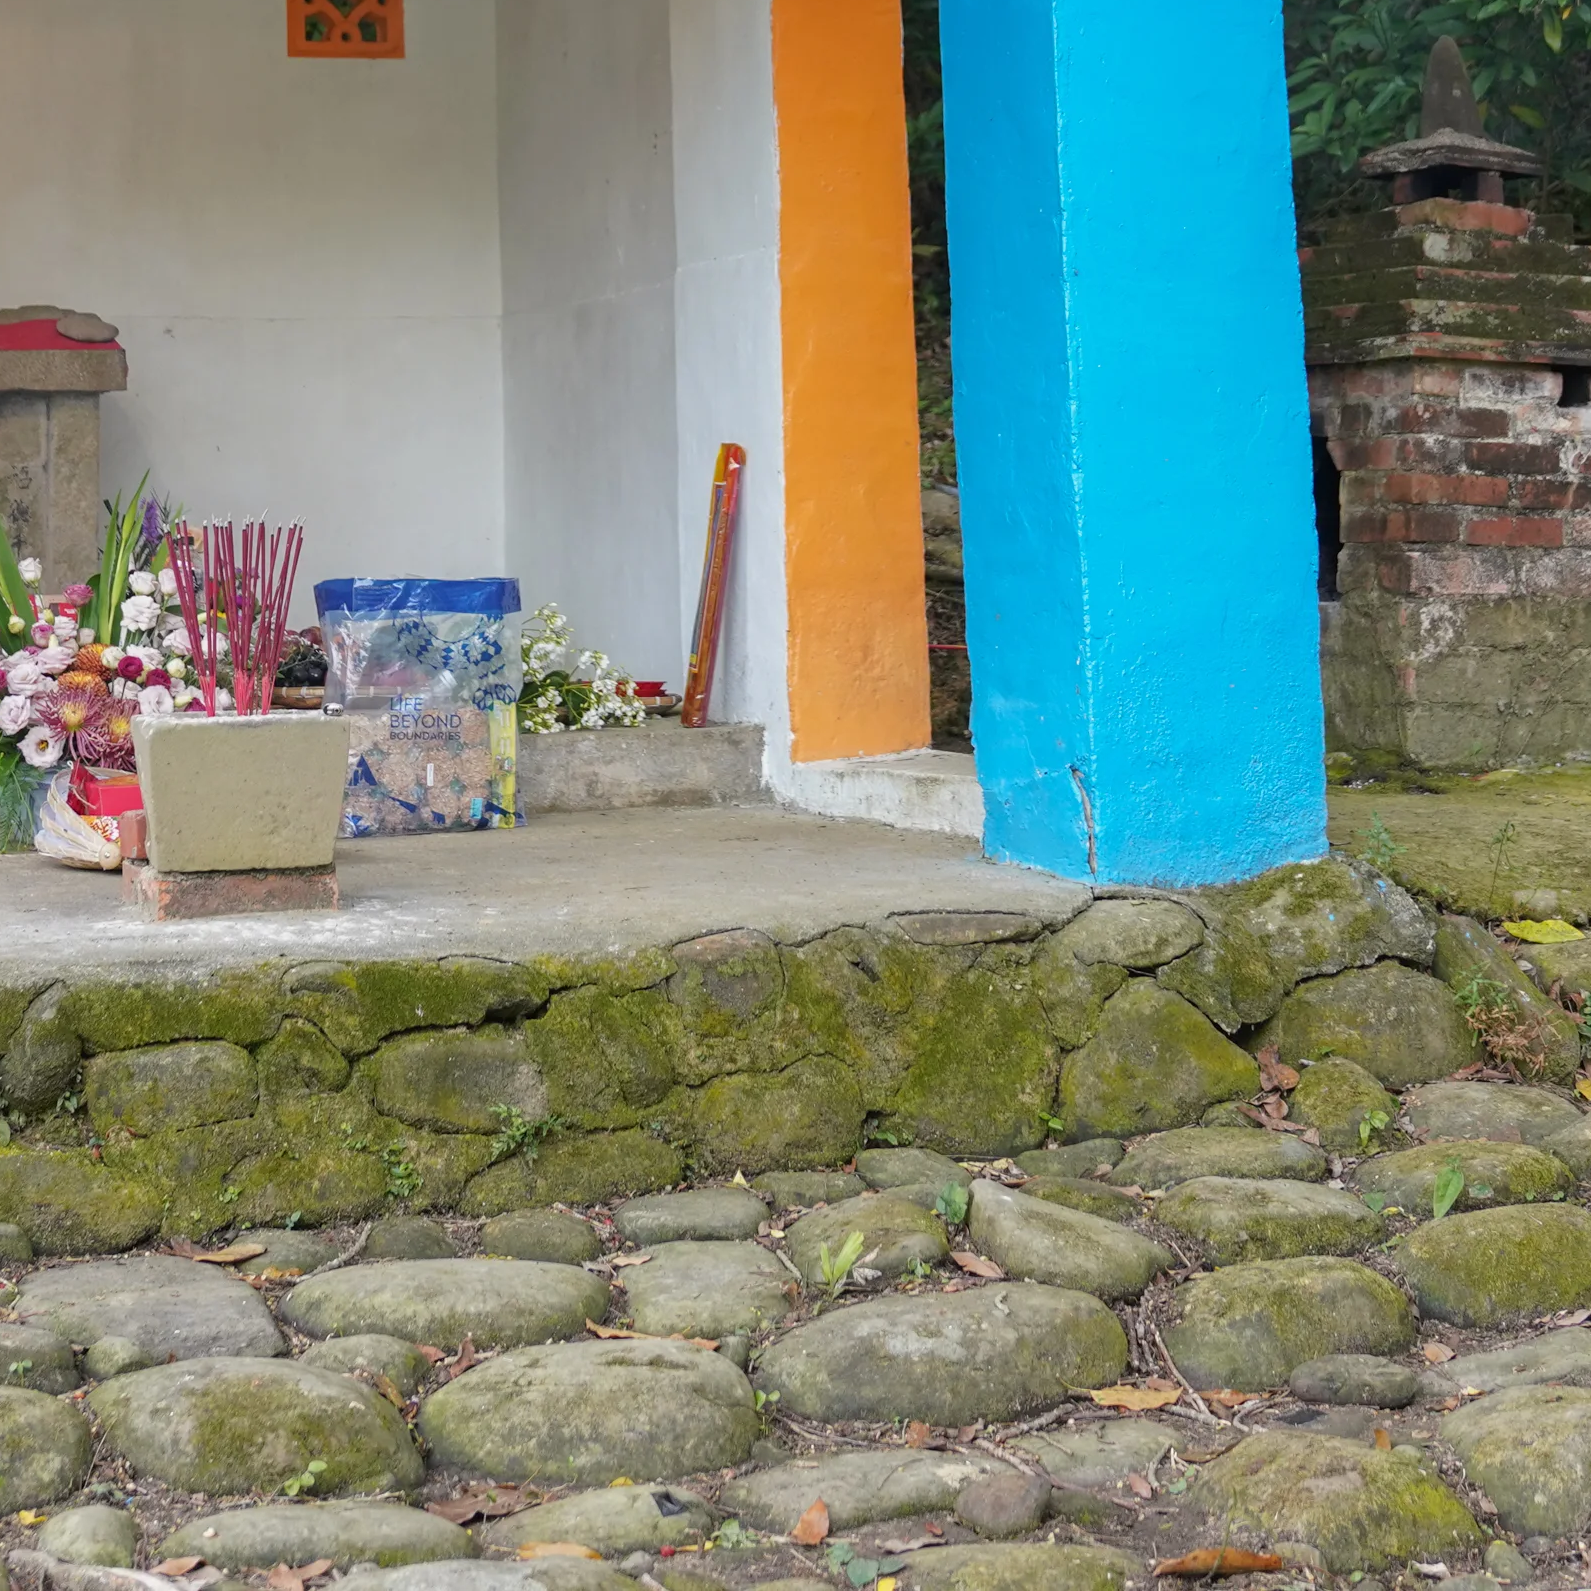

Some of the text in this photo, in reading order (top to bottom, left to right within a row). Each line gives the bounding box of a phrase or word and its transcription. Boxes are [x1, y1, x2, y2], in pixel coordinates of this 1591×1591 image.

[389, 693, 424, 712] LIFE
[389, 713, 462, 729] BEYOND
[389, 731, 461, 741] BOUNDARIES
